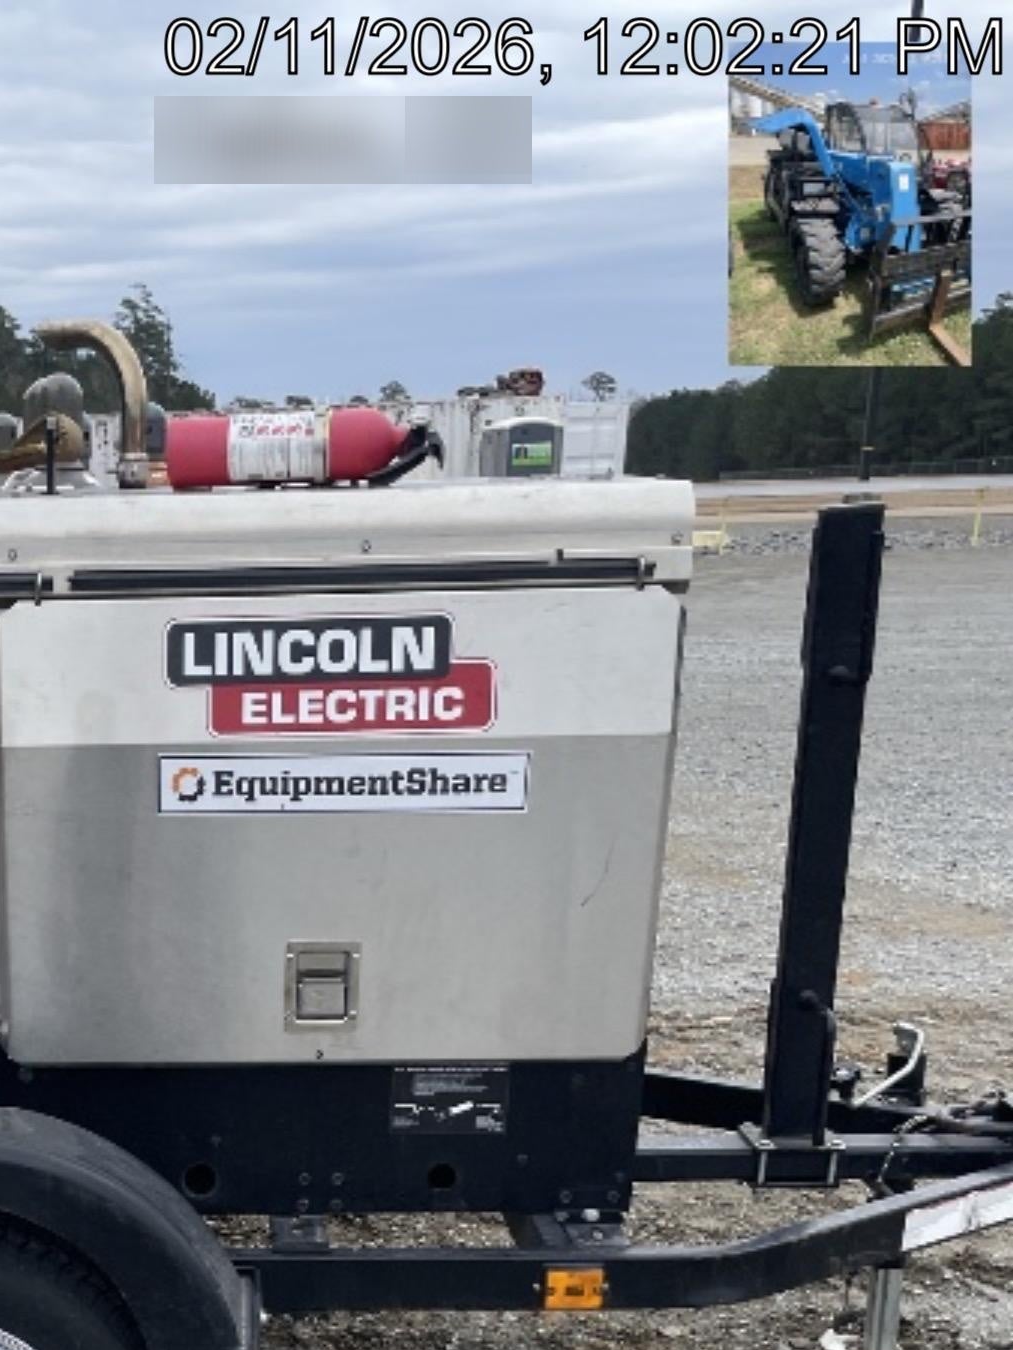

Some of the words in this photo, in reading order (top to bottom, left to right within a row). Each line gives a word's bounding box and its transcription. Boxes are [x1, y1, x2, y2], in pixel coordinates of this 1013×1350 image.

[181, 626, 436, 677] LINCOLN
[241, 687, 466, 726] ELECTRIC
[212, 768, 508, 802] EquipmentShare
